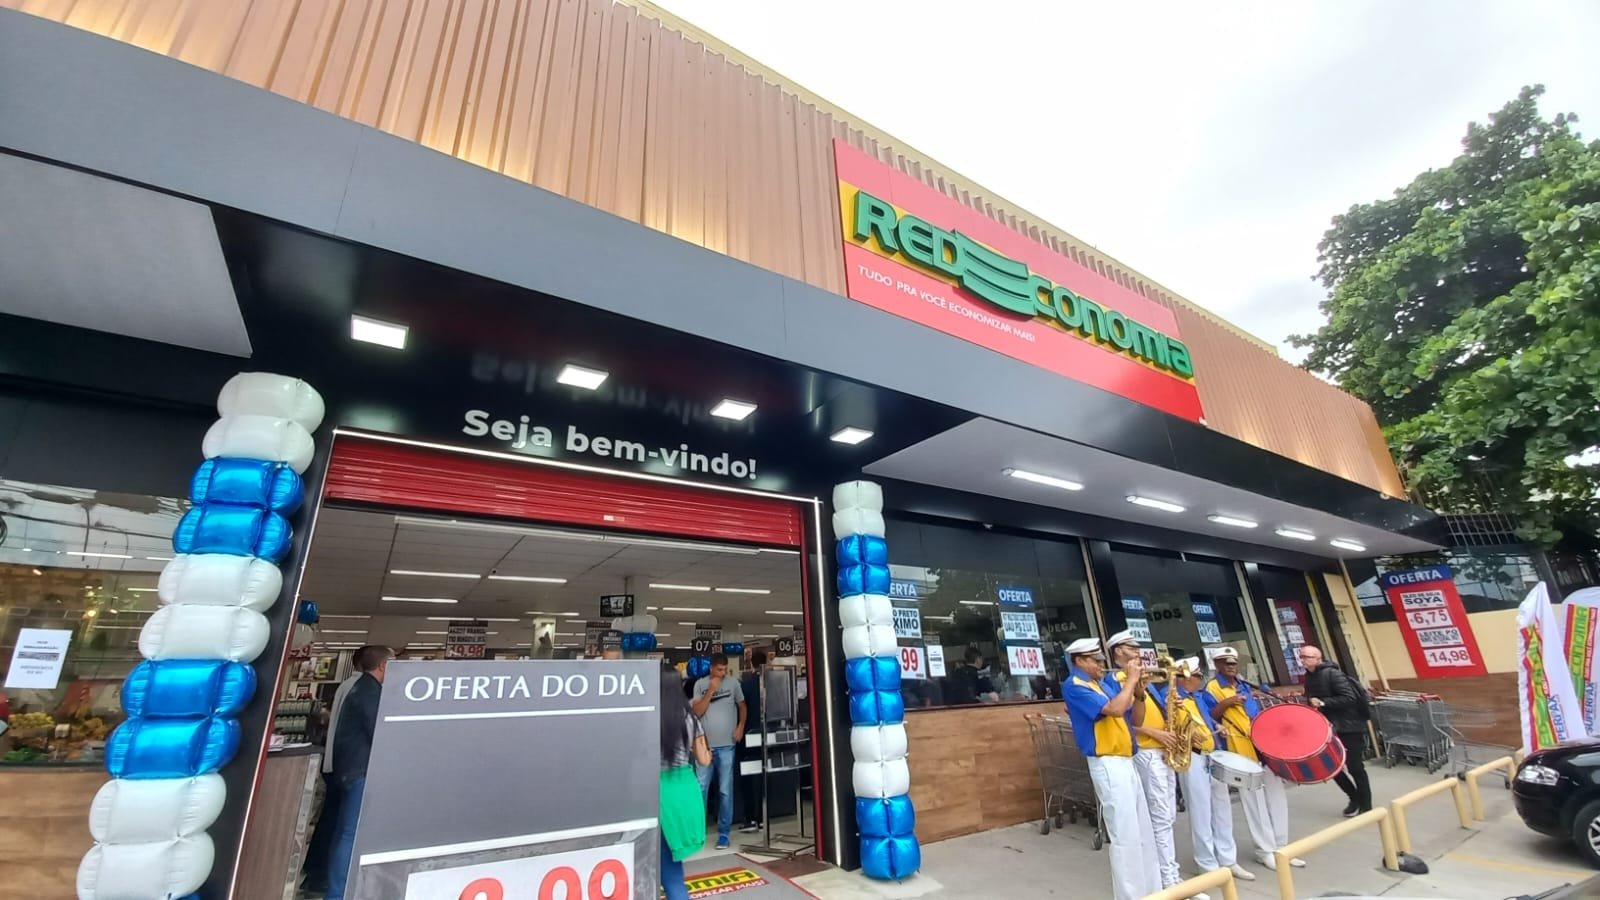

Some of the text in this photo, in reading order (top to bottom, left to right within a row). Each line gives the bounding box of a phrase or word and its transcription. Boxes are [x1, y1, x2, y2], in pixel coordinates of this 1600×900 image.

[858, 265, 1036, 343] TUDO PRA VOCÊ ECONOMIZAR MAIS!
[462, 409, 757, 480] Seja bem-vindo!
[1389, 569, 1442, 585] OFERTA
[890, 582, 917, 596] ERTA
[999, 589, 1032, 603] OFERTA
[1404, 596, 1443, 605] SOYA
[1192, 604, 1214, 614] OFERTA
[893, 618, 918, 630] XIMO
[1413, 609, 1448, 625] 6,75
[695, 640, 709, 651] 07
[779, 640, 791, 651] 06
[1016, 648, 1039, 671] 10,98
[1430, 650, 1468, 663] 14,98
[404, 673, 645, 701] OFERTA DO DIA
[1548, 695, 1566, 741] PERPAX
